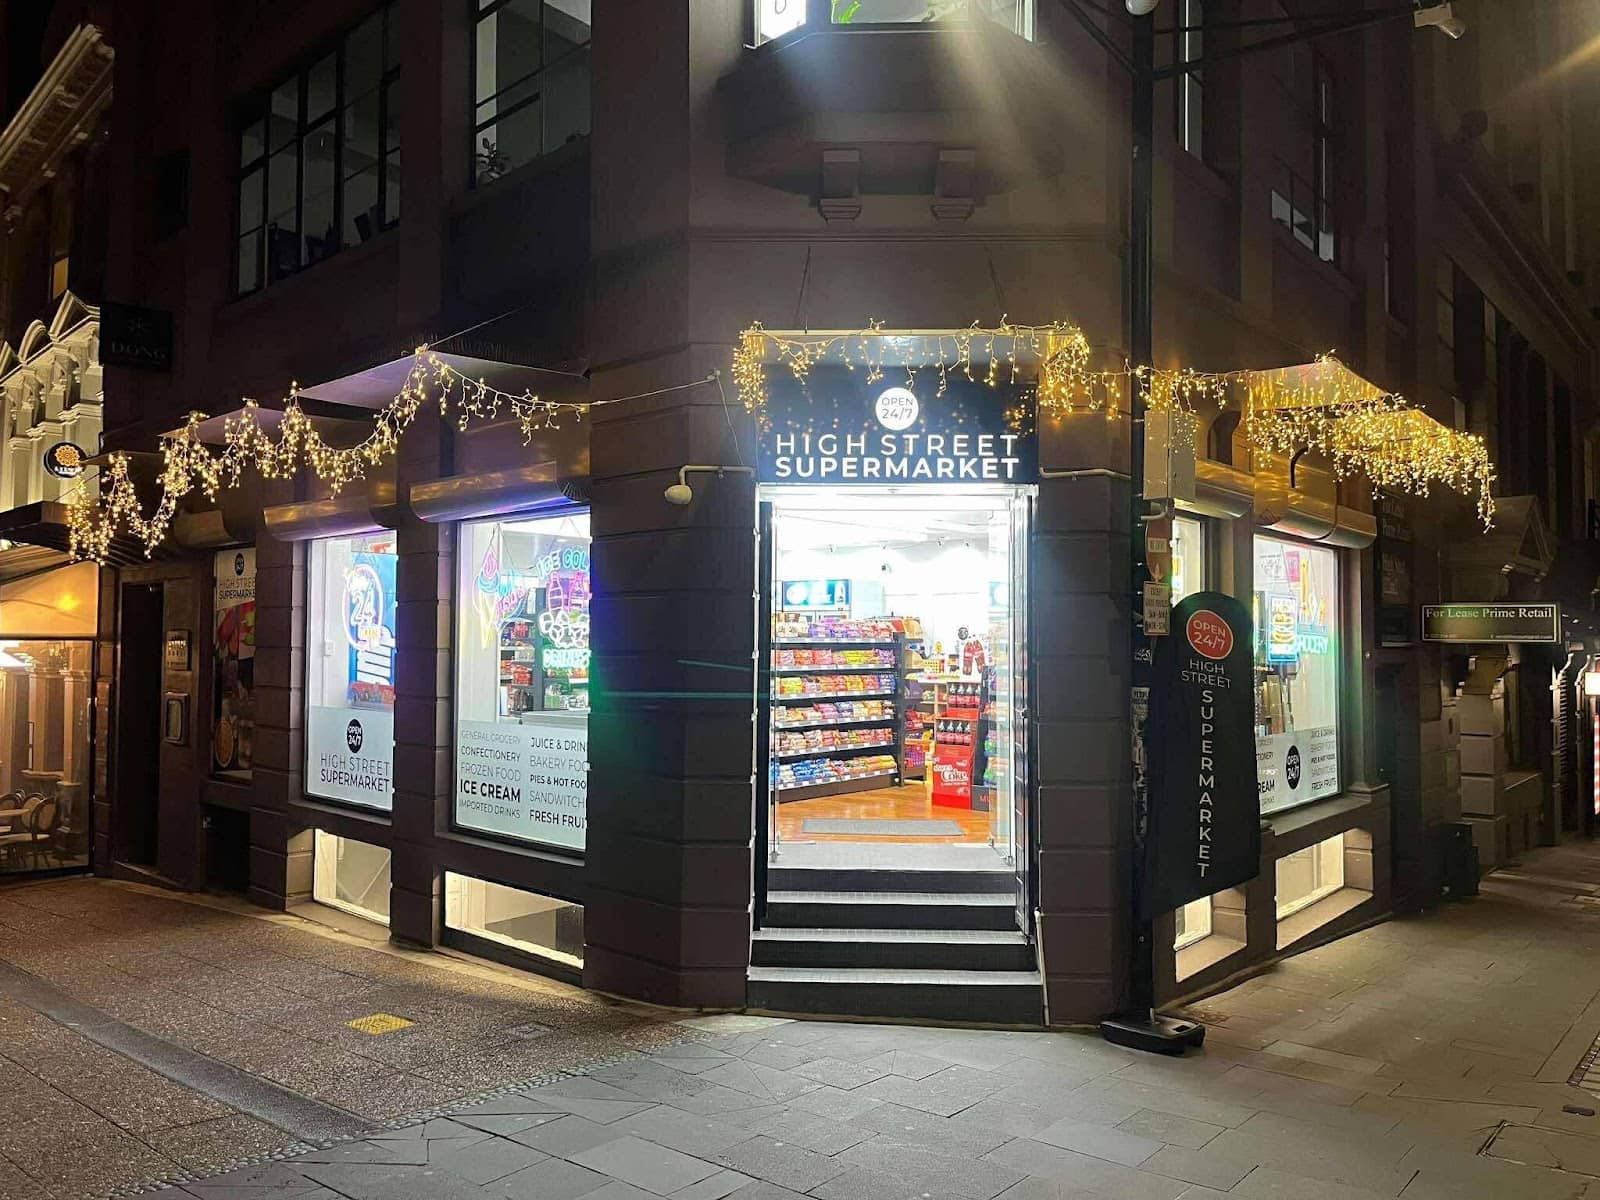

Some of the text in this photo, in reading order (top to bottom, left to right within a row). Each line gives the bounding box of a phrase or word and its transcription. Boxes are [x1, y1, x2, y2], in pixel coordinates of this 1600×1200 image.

[881, 397, 913, 407] OPEN
[882, 408, 913, 420] 24/7
[776, 434, 1019, 456] HIGH STREET
[775, 457, 1019, 478] SUPERMARKET
[536, 550, 562, 579] ICE
[1426, 607, 1552, 618] For Lease Prime Retail
[1193, 619, 1226, 637] OPEN
[1193, 631, 1226, 650] 24/7
[1189, 658, 1225, 675] HIGH
[1181, 670, 1231, 689] STREET
[347, 726, 361, 734] OPEN
[461, 730, 520, 745] GENERAL GROCERY
[348, 735, 361, 746] 24/7
[531, 737, 554, 749] JUICE
[556, 740, 562, 750] &
[461, 745, 520, 762] CONFECTIONERY
[530, 755, 565, 769] BAKERY
[320, 752, 390, 776] HIGH STREET
[460, 761, 521, 782] FROZEN FOOD
[320, 769, 390, 792] SUPERMARKET
[530, 774, 545, 784] PIES
[547, 776, 552, 785] &
[553, 777, 569, 787] HOT
[1197, 690, 1215, 878] SUPERMARKET
[460, 779, 520, 803] ICE CREAM
[460, 799, 521, 819] IMPORTED DRINKS
[529, 809, 559, 825] FRESH
